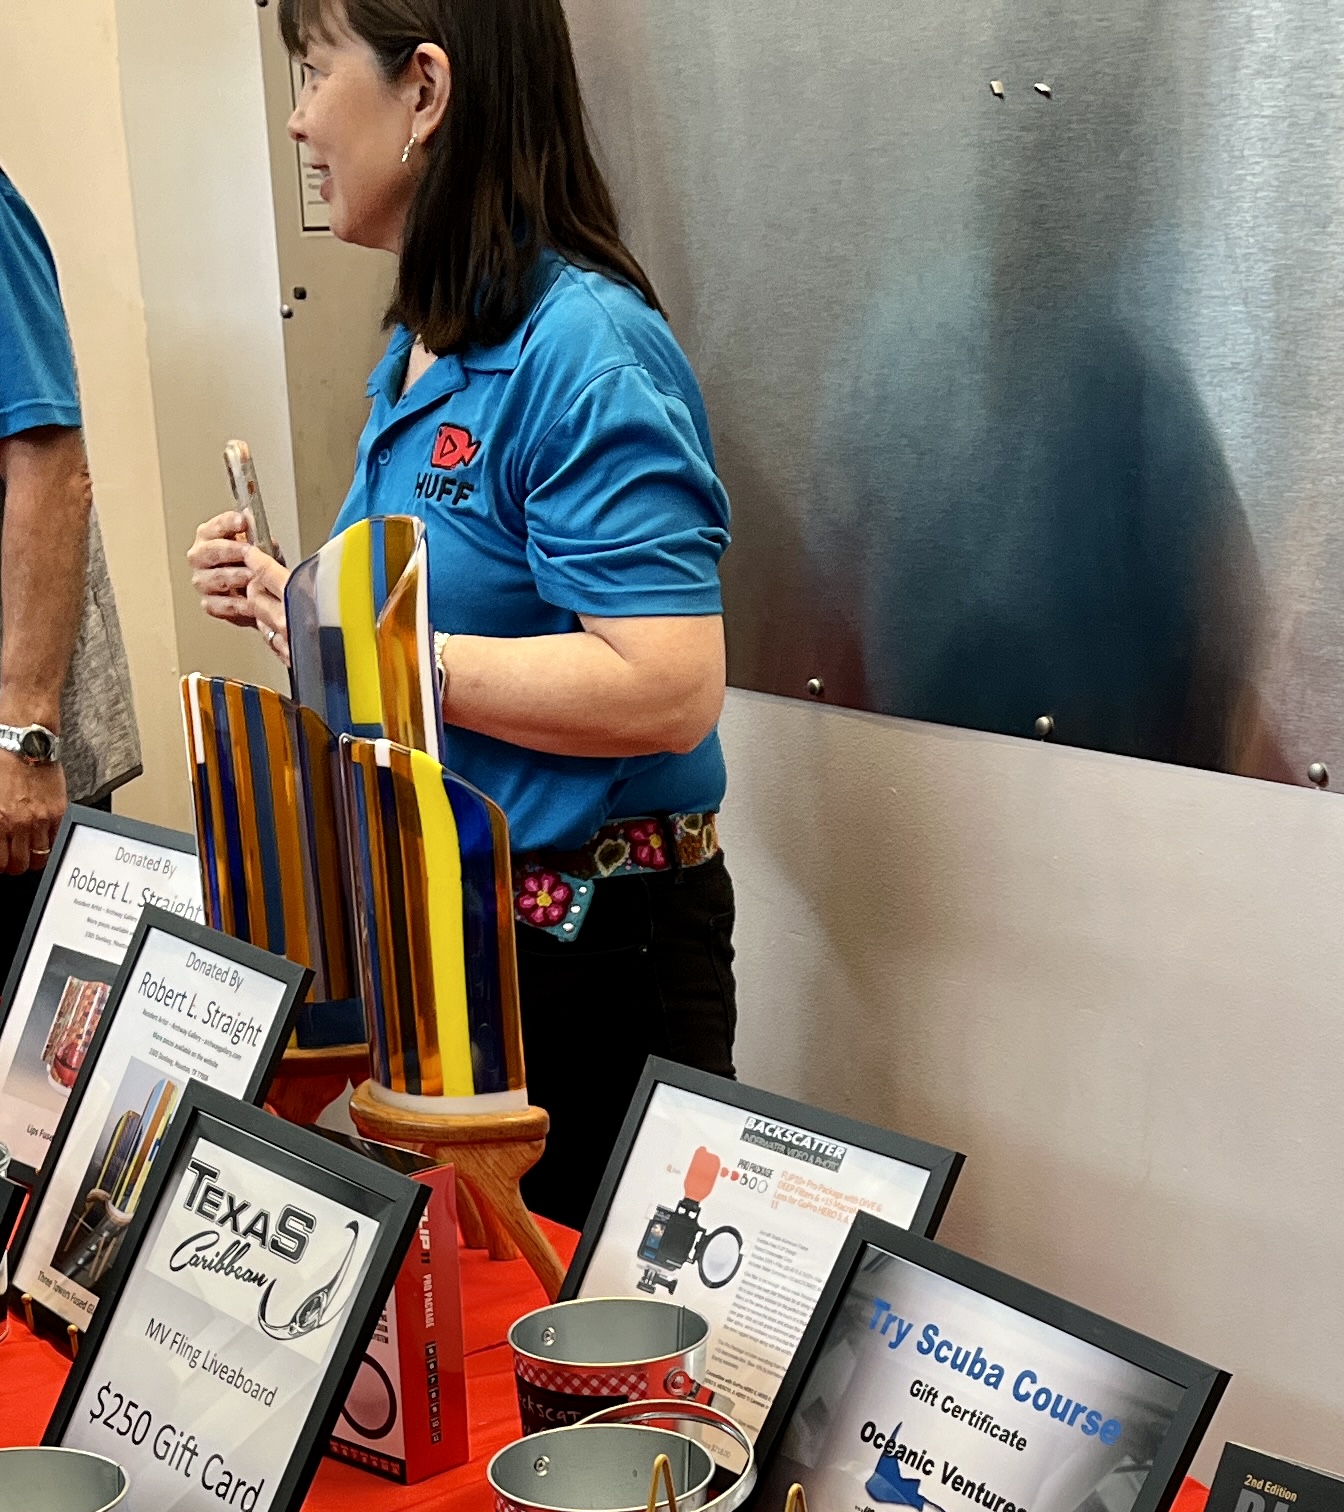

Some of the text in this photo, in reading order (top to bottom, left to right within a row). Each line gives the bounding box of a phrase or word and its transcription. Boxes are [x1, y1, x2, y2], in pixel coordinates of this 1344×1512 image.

[415, 472, 474, 505] HUFF
[68, 867, 119, 900] Robert
[121, 882, 133, 904] L.
[115, 847, 177, 878] Donated By
[186, 952, 244, 993] Donated By
[138, 972, 262, 1047] Robert L. Straight
[745, 1117, 846, 1159] BACKSCATTER
[737, 1159, 751, 1170] PRO
[183, 1157, 317, 1266] TEXAS
[169, 1230, 268, 1288] Caribbean
[37, 1270, 53, 1288] Three
[70, 1293, 88, 1311] Fused
[146, 1317, 278, 1409] MV Fling Liveaboard
[868, 1298, 1122, 1447] Try Scuba Course
[90, 1381, 152, 1449] $250
[153, 1422, 197, 1480] Gift
[910, 1379, 1027, 1452] Gift Certificate
[860, 1421, 935, 1477] Oceanic
[1244, 1474, 1298, 1503] 2nd Edition
